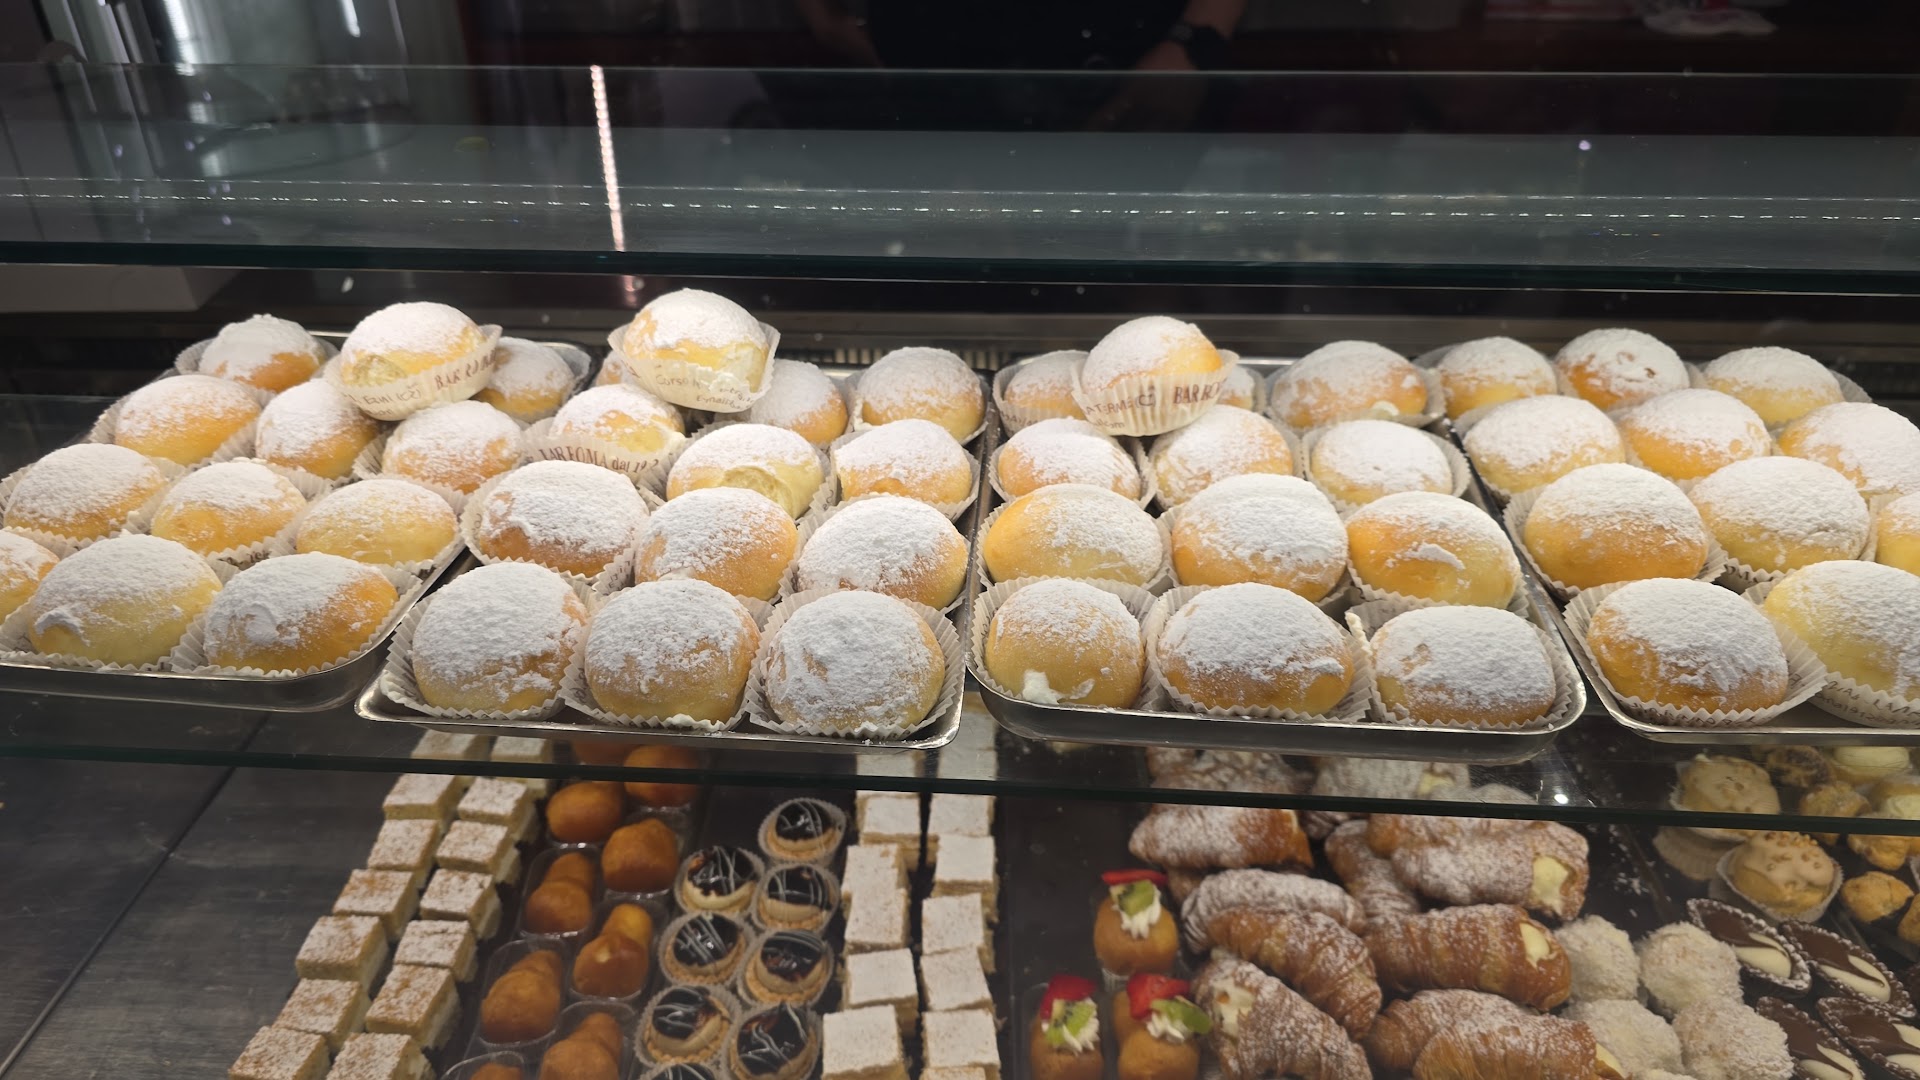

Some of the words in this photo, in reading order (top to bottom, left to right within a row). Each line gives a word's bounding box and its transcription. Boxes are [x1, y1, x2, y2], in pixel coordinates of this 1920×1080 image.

[655, 374, 689, 386] Corso
[1172, 383, 1200, 404] BAR
[612, 457, 630, 473] dal
